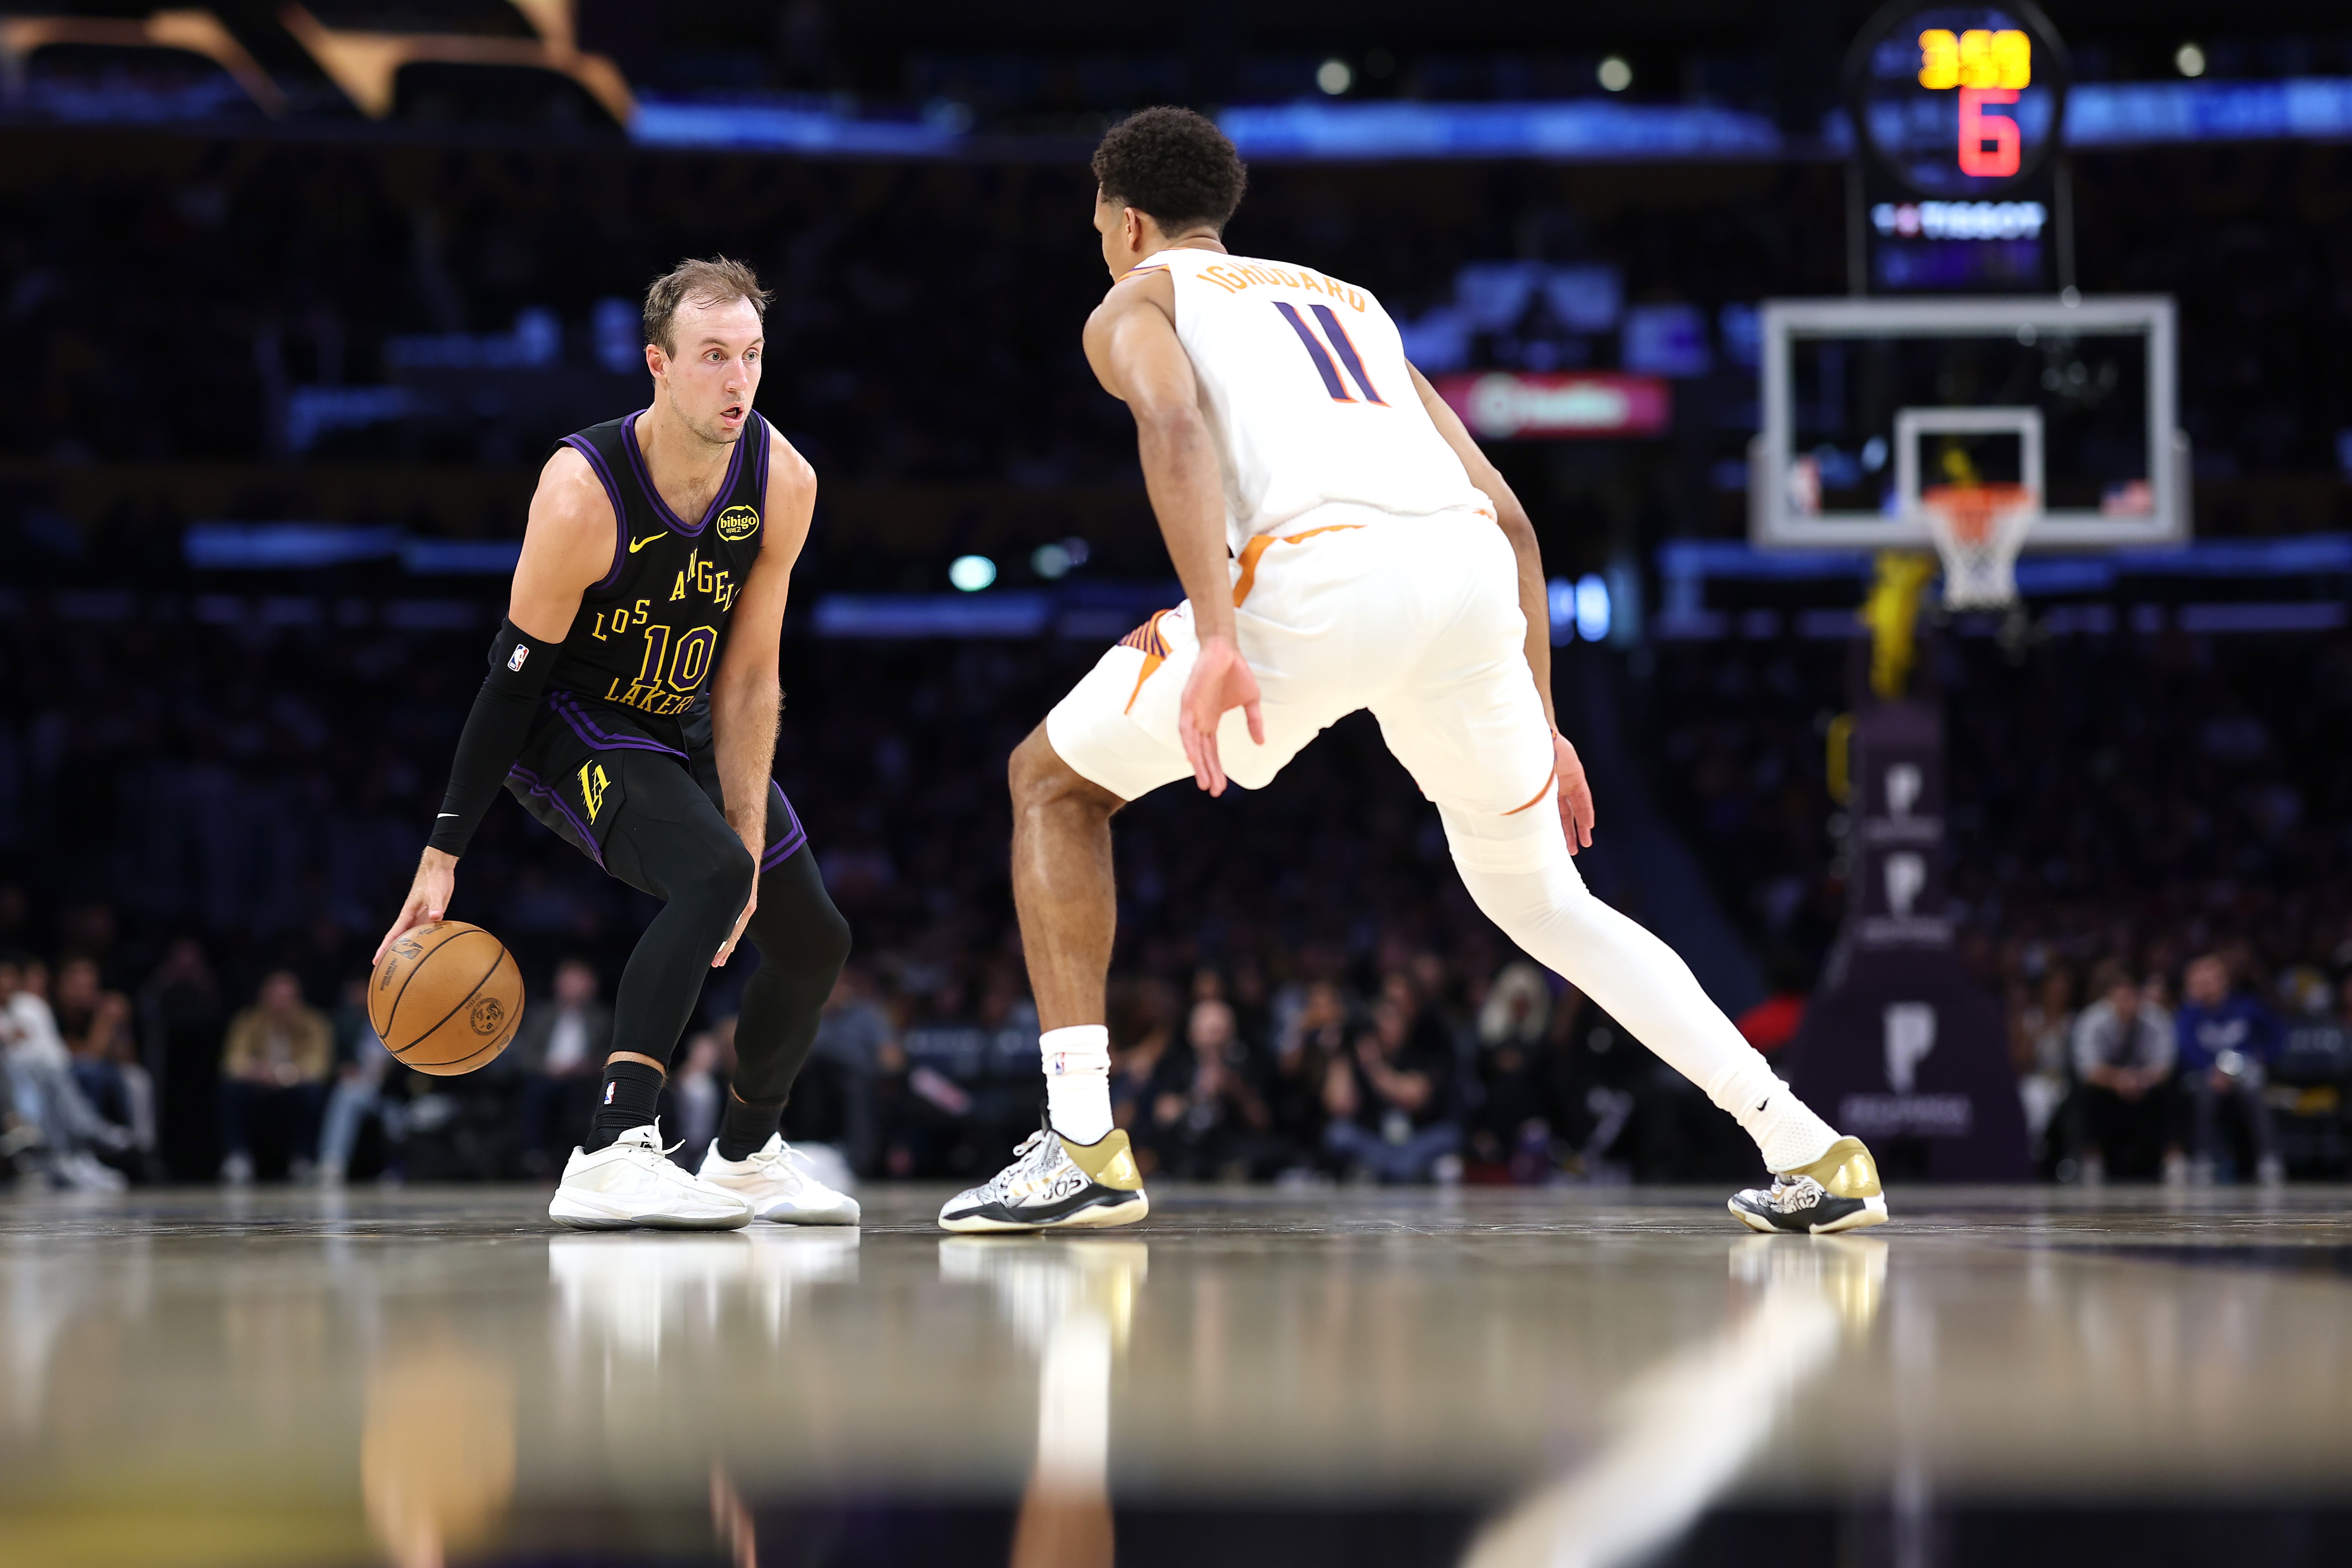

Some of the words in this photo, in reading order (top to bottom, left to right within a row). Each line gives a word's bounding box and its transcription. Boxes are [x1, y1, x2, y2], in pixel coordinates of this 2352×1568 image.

[1958, 86, 2020, 177] 6
[1270, 301, 1393, 408] 11
[720, 515, 756, 530] bibigo
[592, 599, 651, 641] LOS
[668, 547, 742, 612] ANGEL
[631, 625, 718, 692] 10
